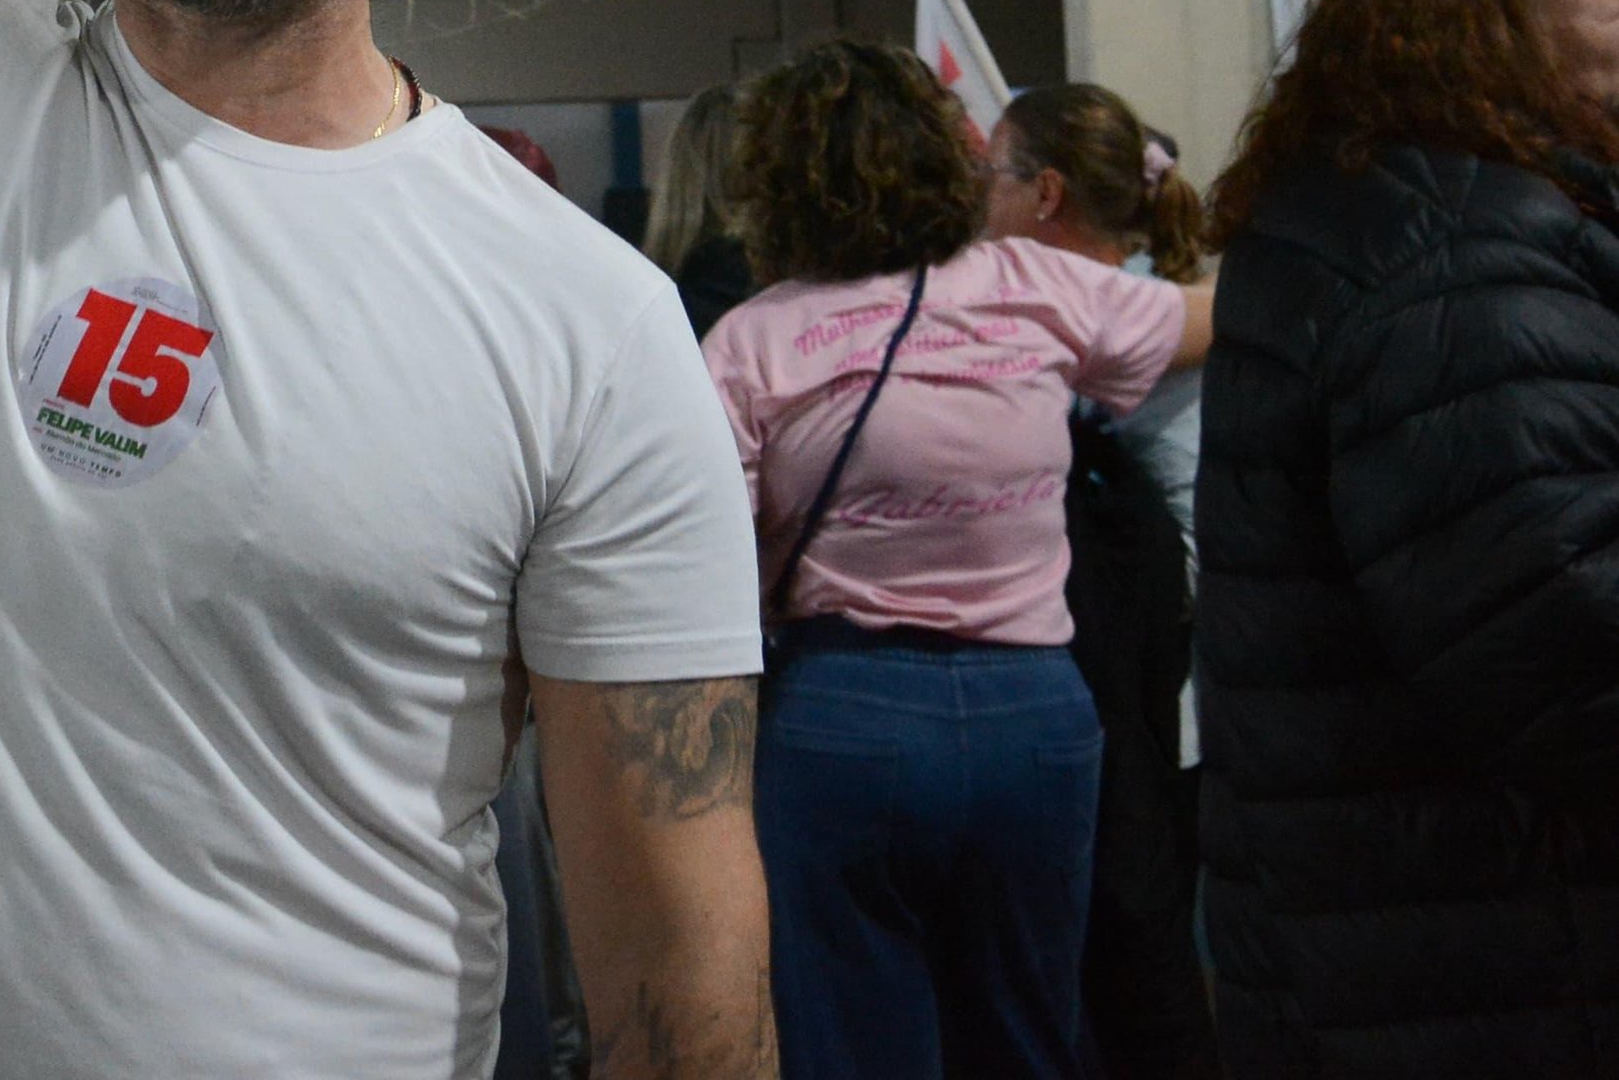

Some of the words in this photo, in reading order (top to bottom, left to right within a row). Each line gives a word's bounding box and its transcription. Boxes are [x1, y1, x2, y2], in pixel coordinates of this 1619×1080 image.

[57, 287, 215, 428] 15
[36, 407, 94, 440] FELIPE
[94, 427, 148, 459] VALIM
